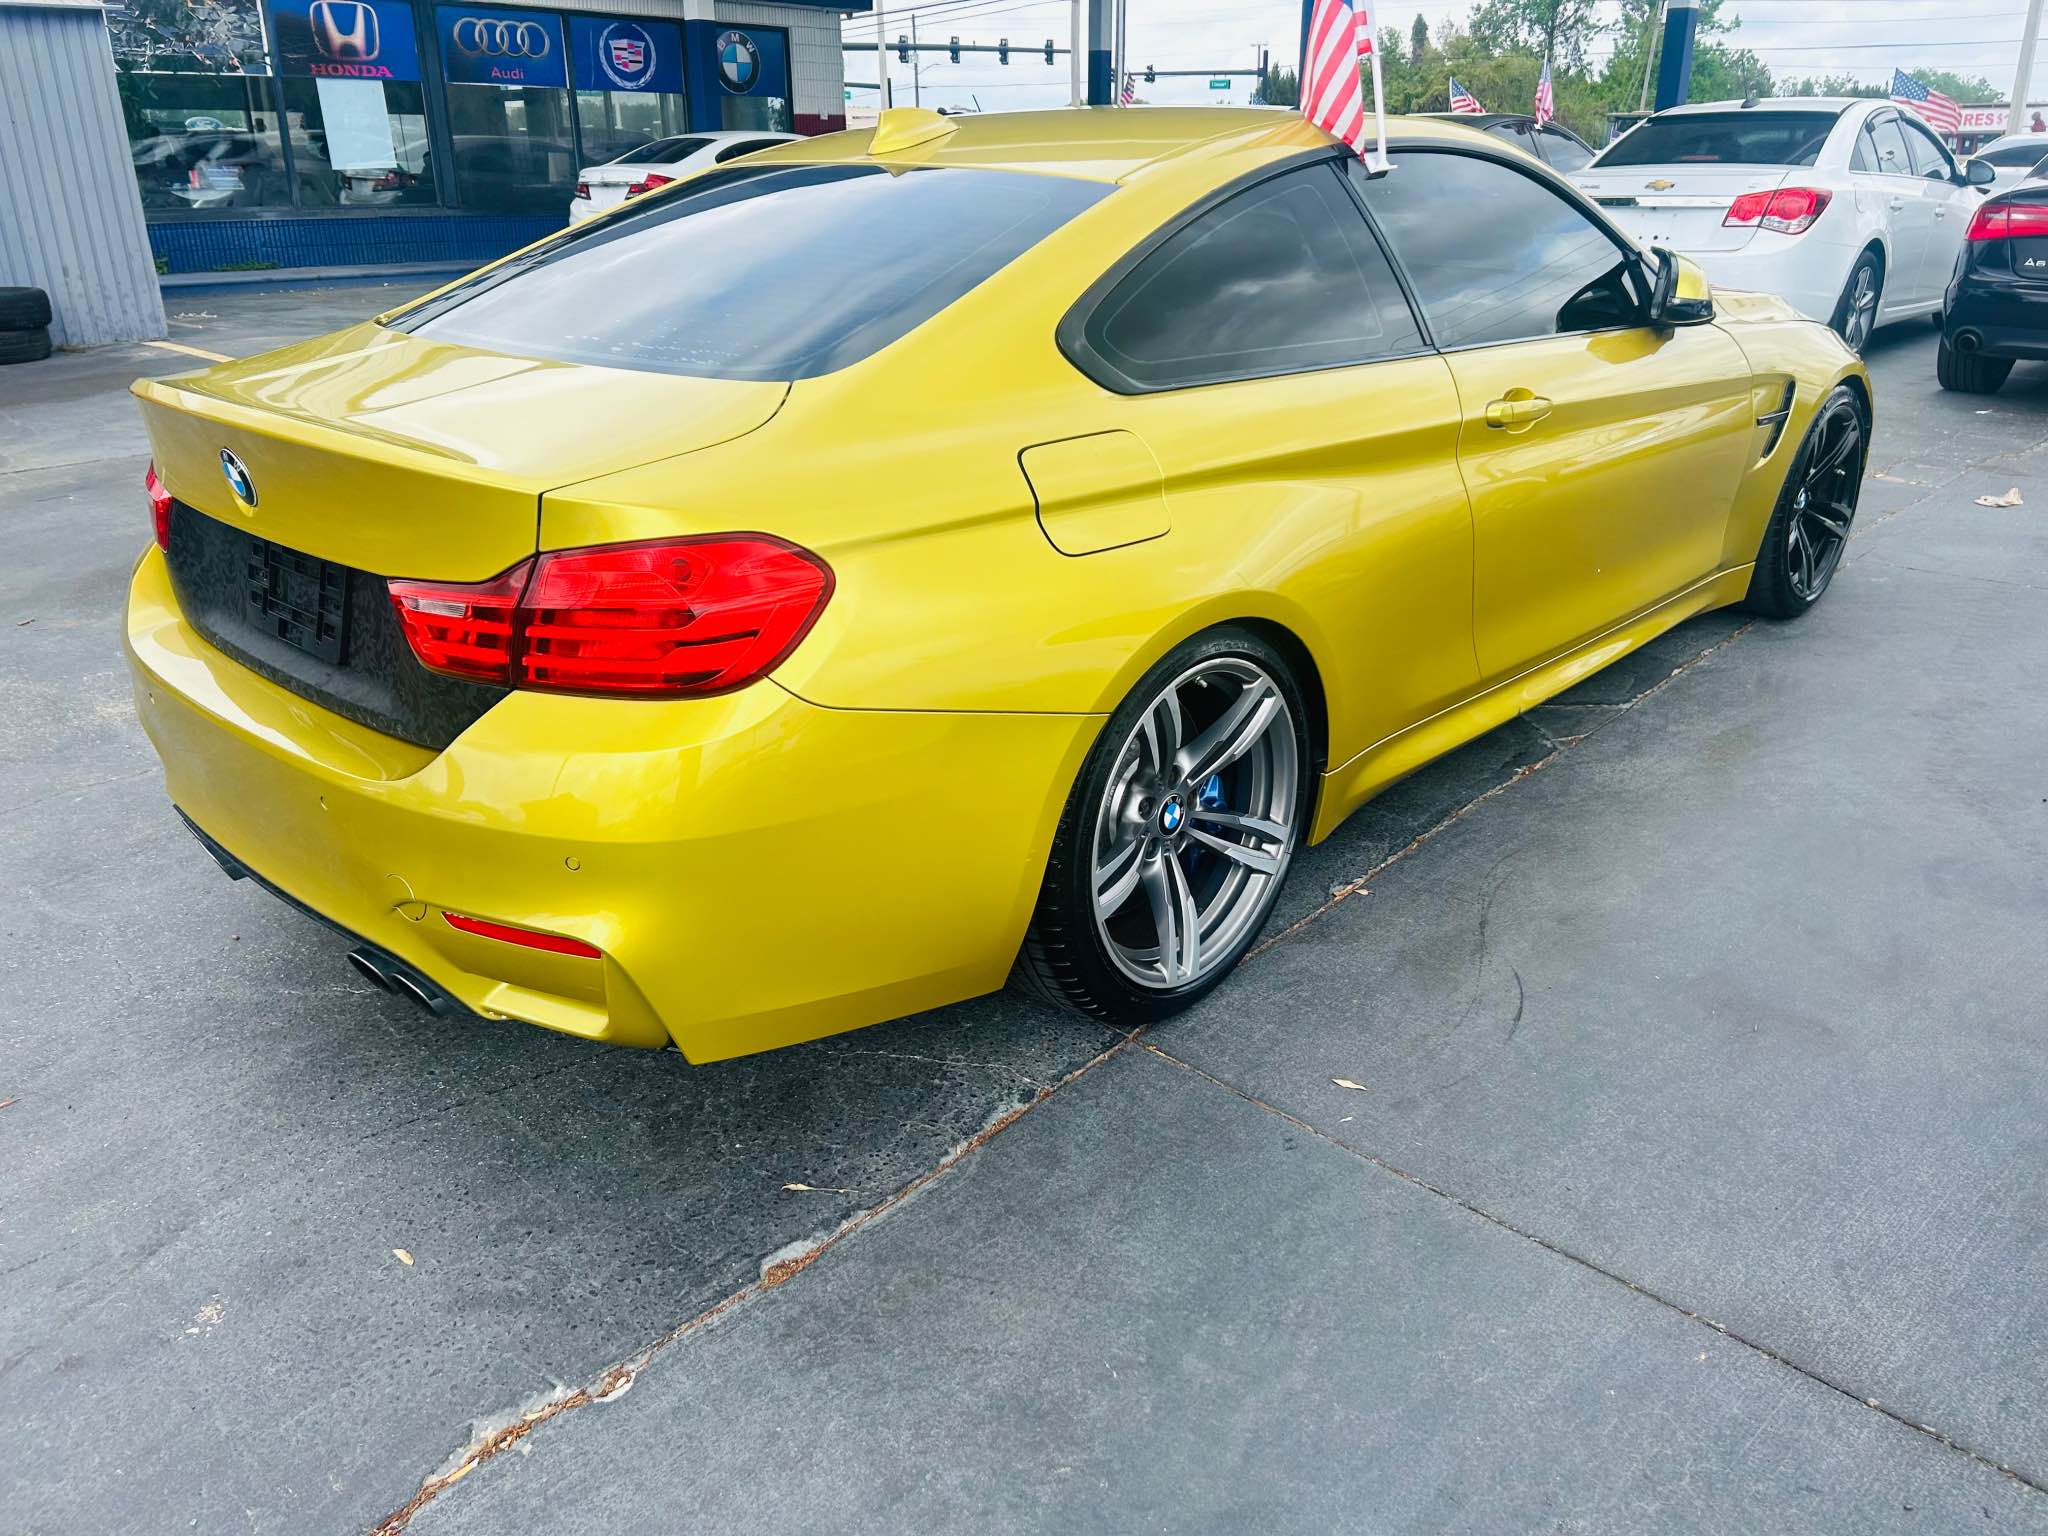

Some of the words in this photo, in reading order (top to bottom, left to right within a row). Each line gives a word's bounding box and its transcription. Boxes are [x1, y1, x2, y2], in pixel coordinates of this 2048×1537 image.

[717, 32, 756, 53] BMW
[310, 63, 394, 78] HONDA
[491, 66, 524, 80] Audi
